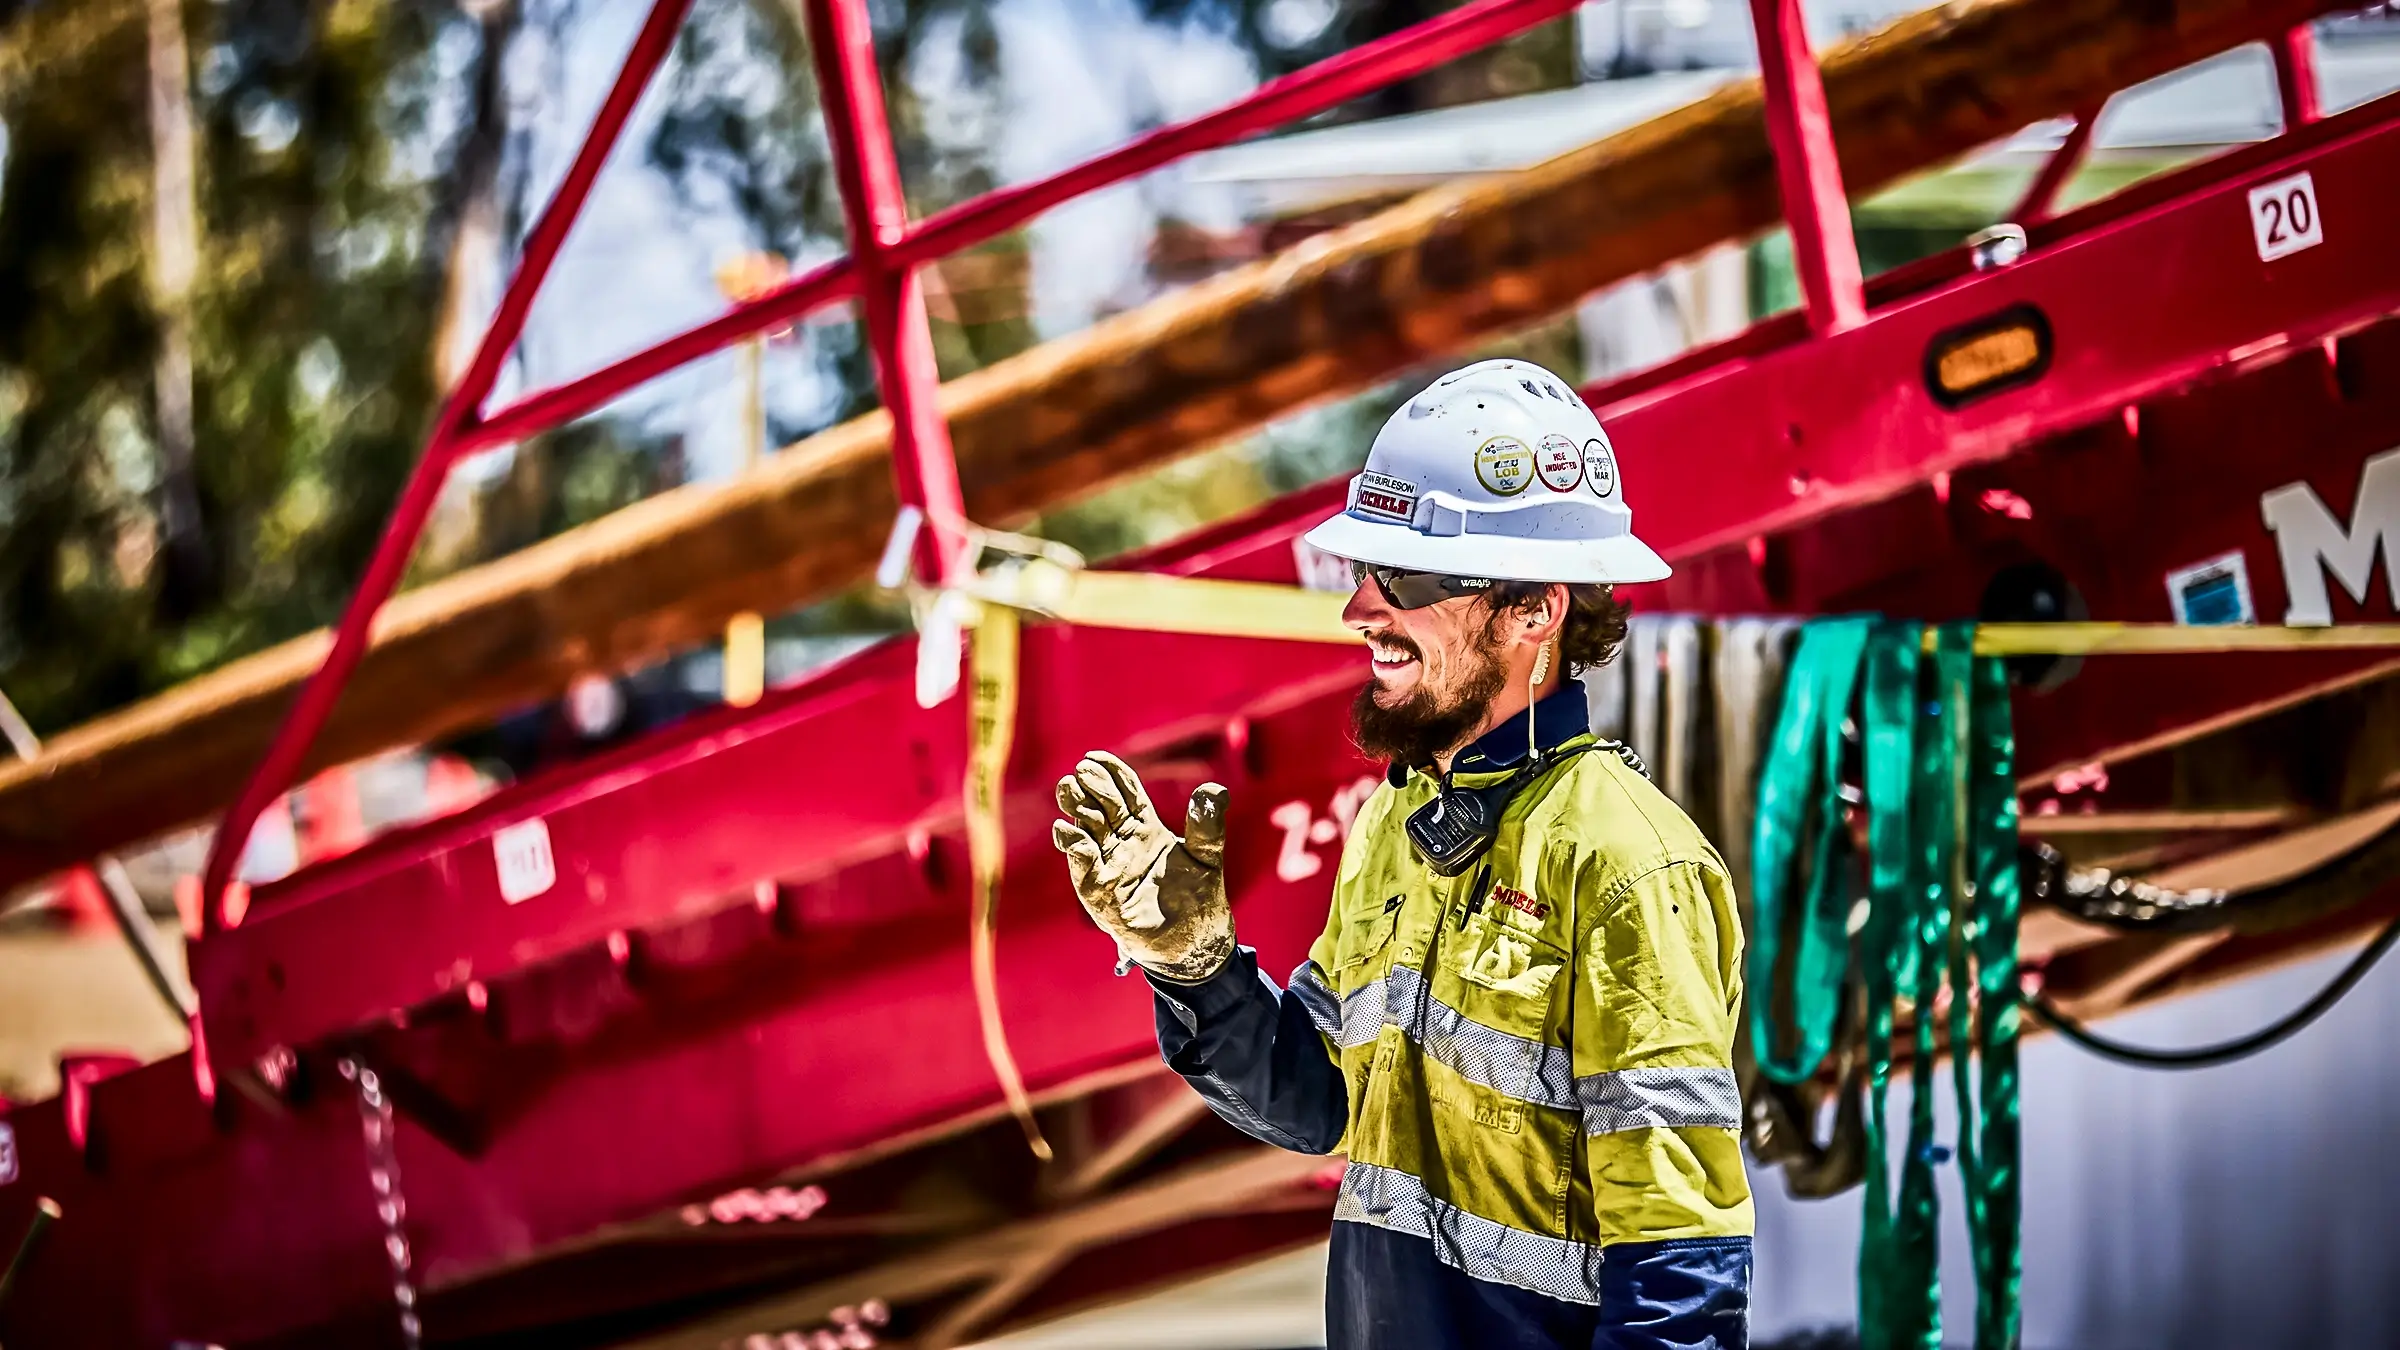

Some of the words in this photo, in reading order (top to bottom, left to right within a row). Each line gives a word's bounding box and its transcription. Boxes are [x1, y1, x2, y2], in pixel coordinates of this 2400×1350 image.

[2260, 189, 2311, 245] 20
[1553, 452, 1566, 462] HSE
[1495, 467, 1520, 478] LOB
[1545, 461, 1577, 473] INDUCTED
[1594, 471, 1609, 480] MAR
[1375, 476, 1414, 493] BURLESON
